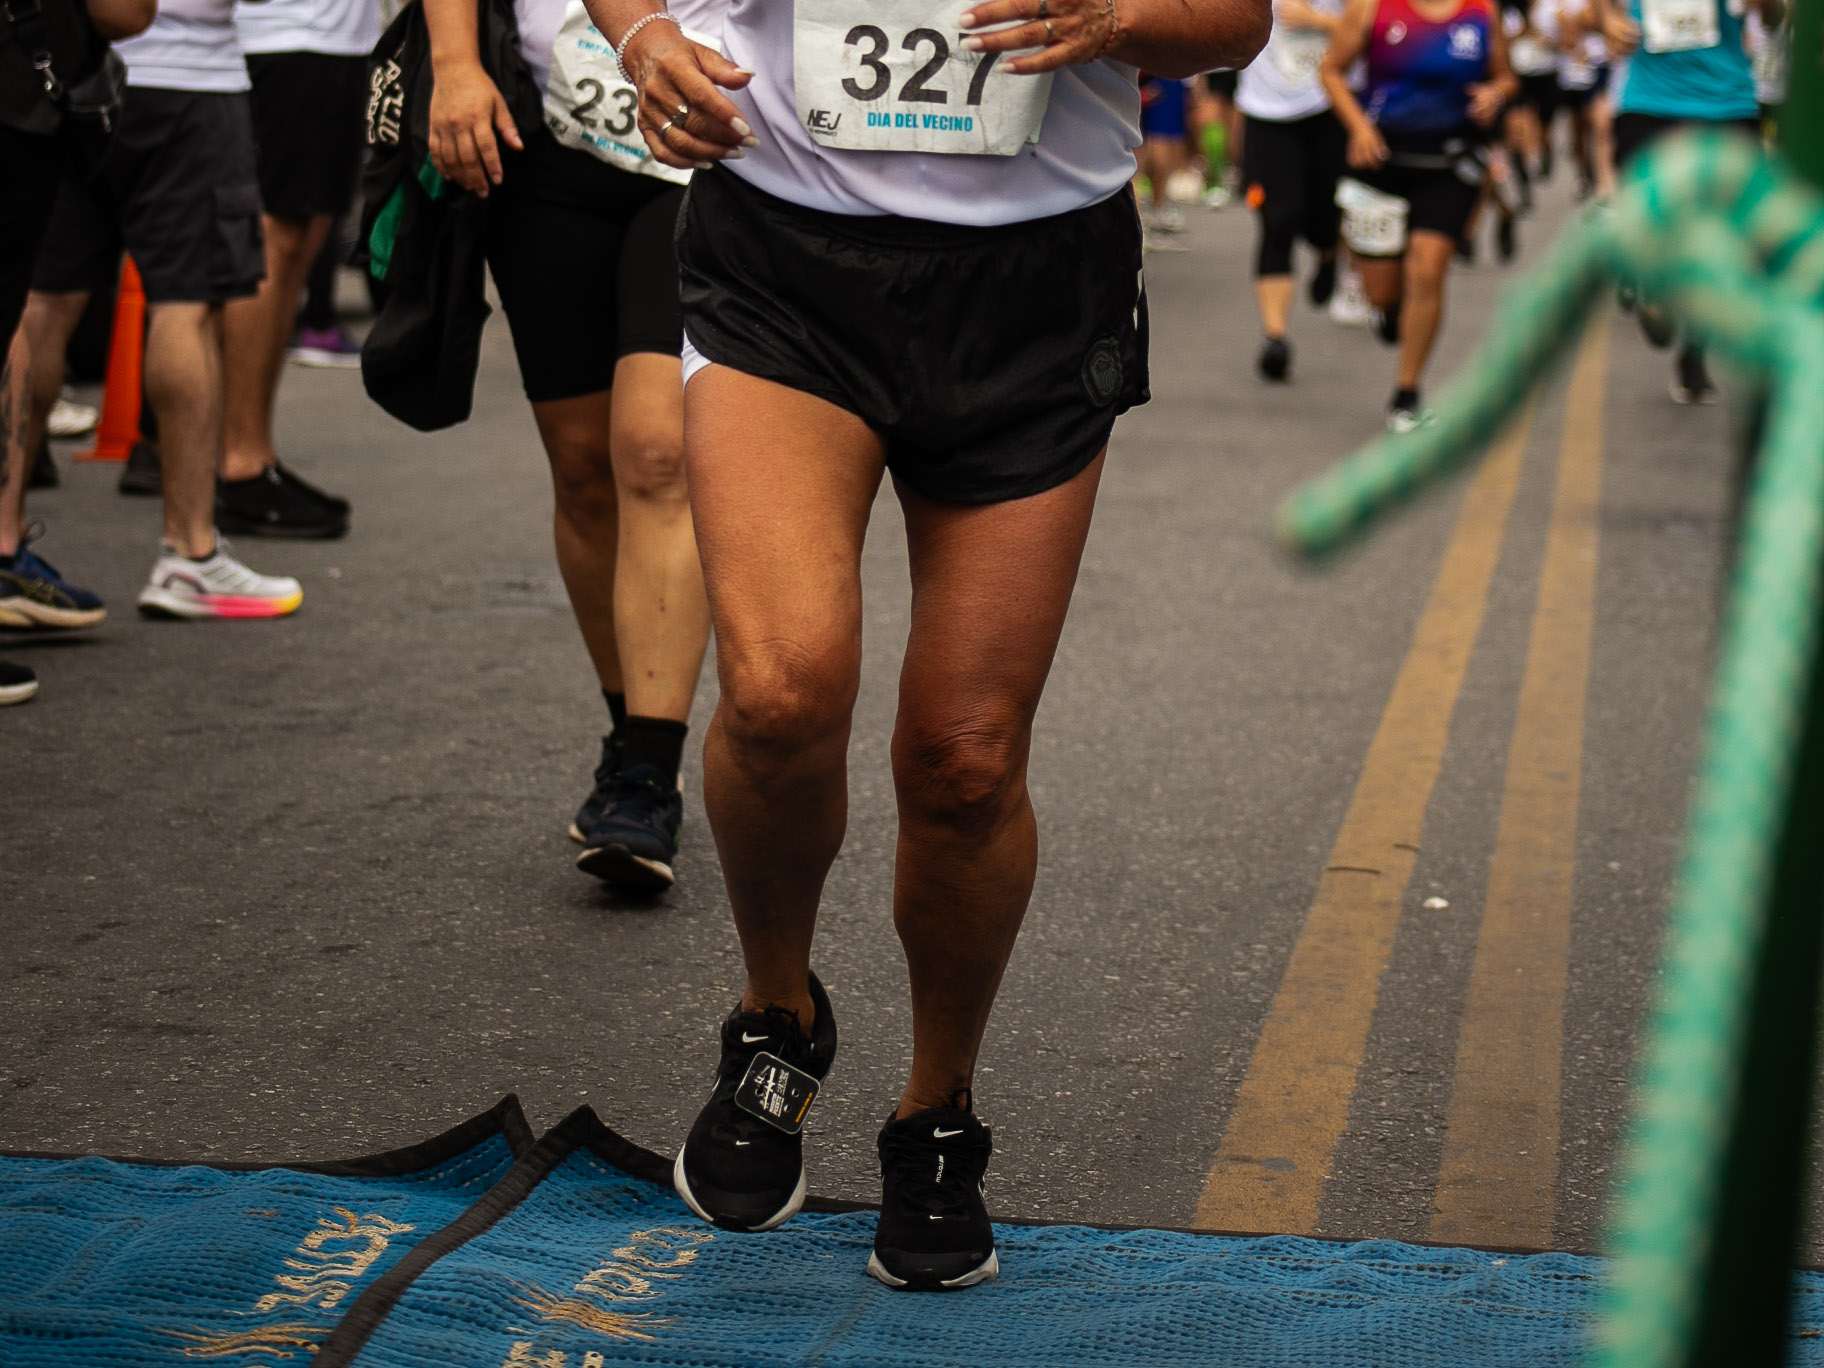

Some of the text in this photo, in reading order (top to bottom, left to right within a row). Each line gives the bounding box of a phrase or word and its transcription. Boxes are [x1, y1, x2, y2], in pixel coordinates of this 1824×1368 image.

[841, 24, 1003, 106] 327
[570, 78, 638, 137] 23
[807, 109, 841, 130] NEJ
[867, 112, 973, 132] DIA DEL VECINO
